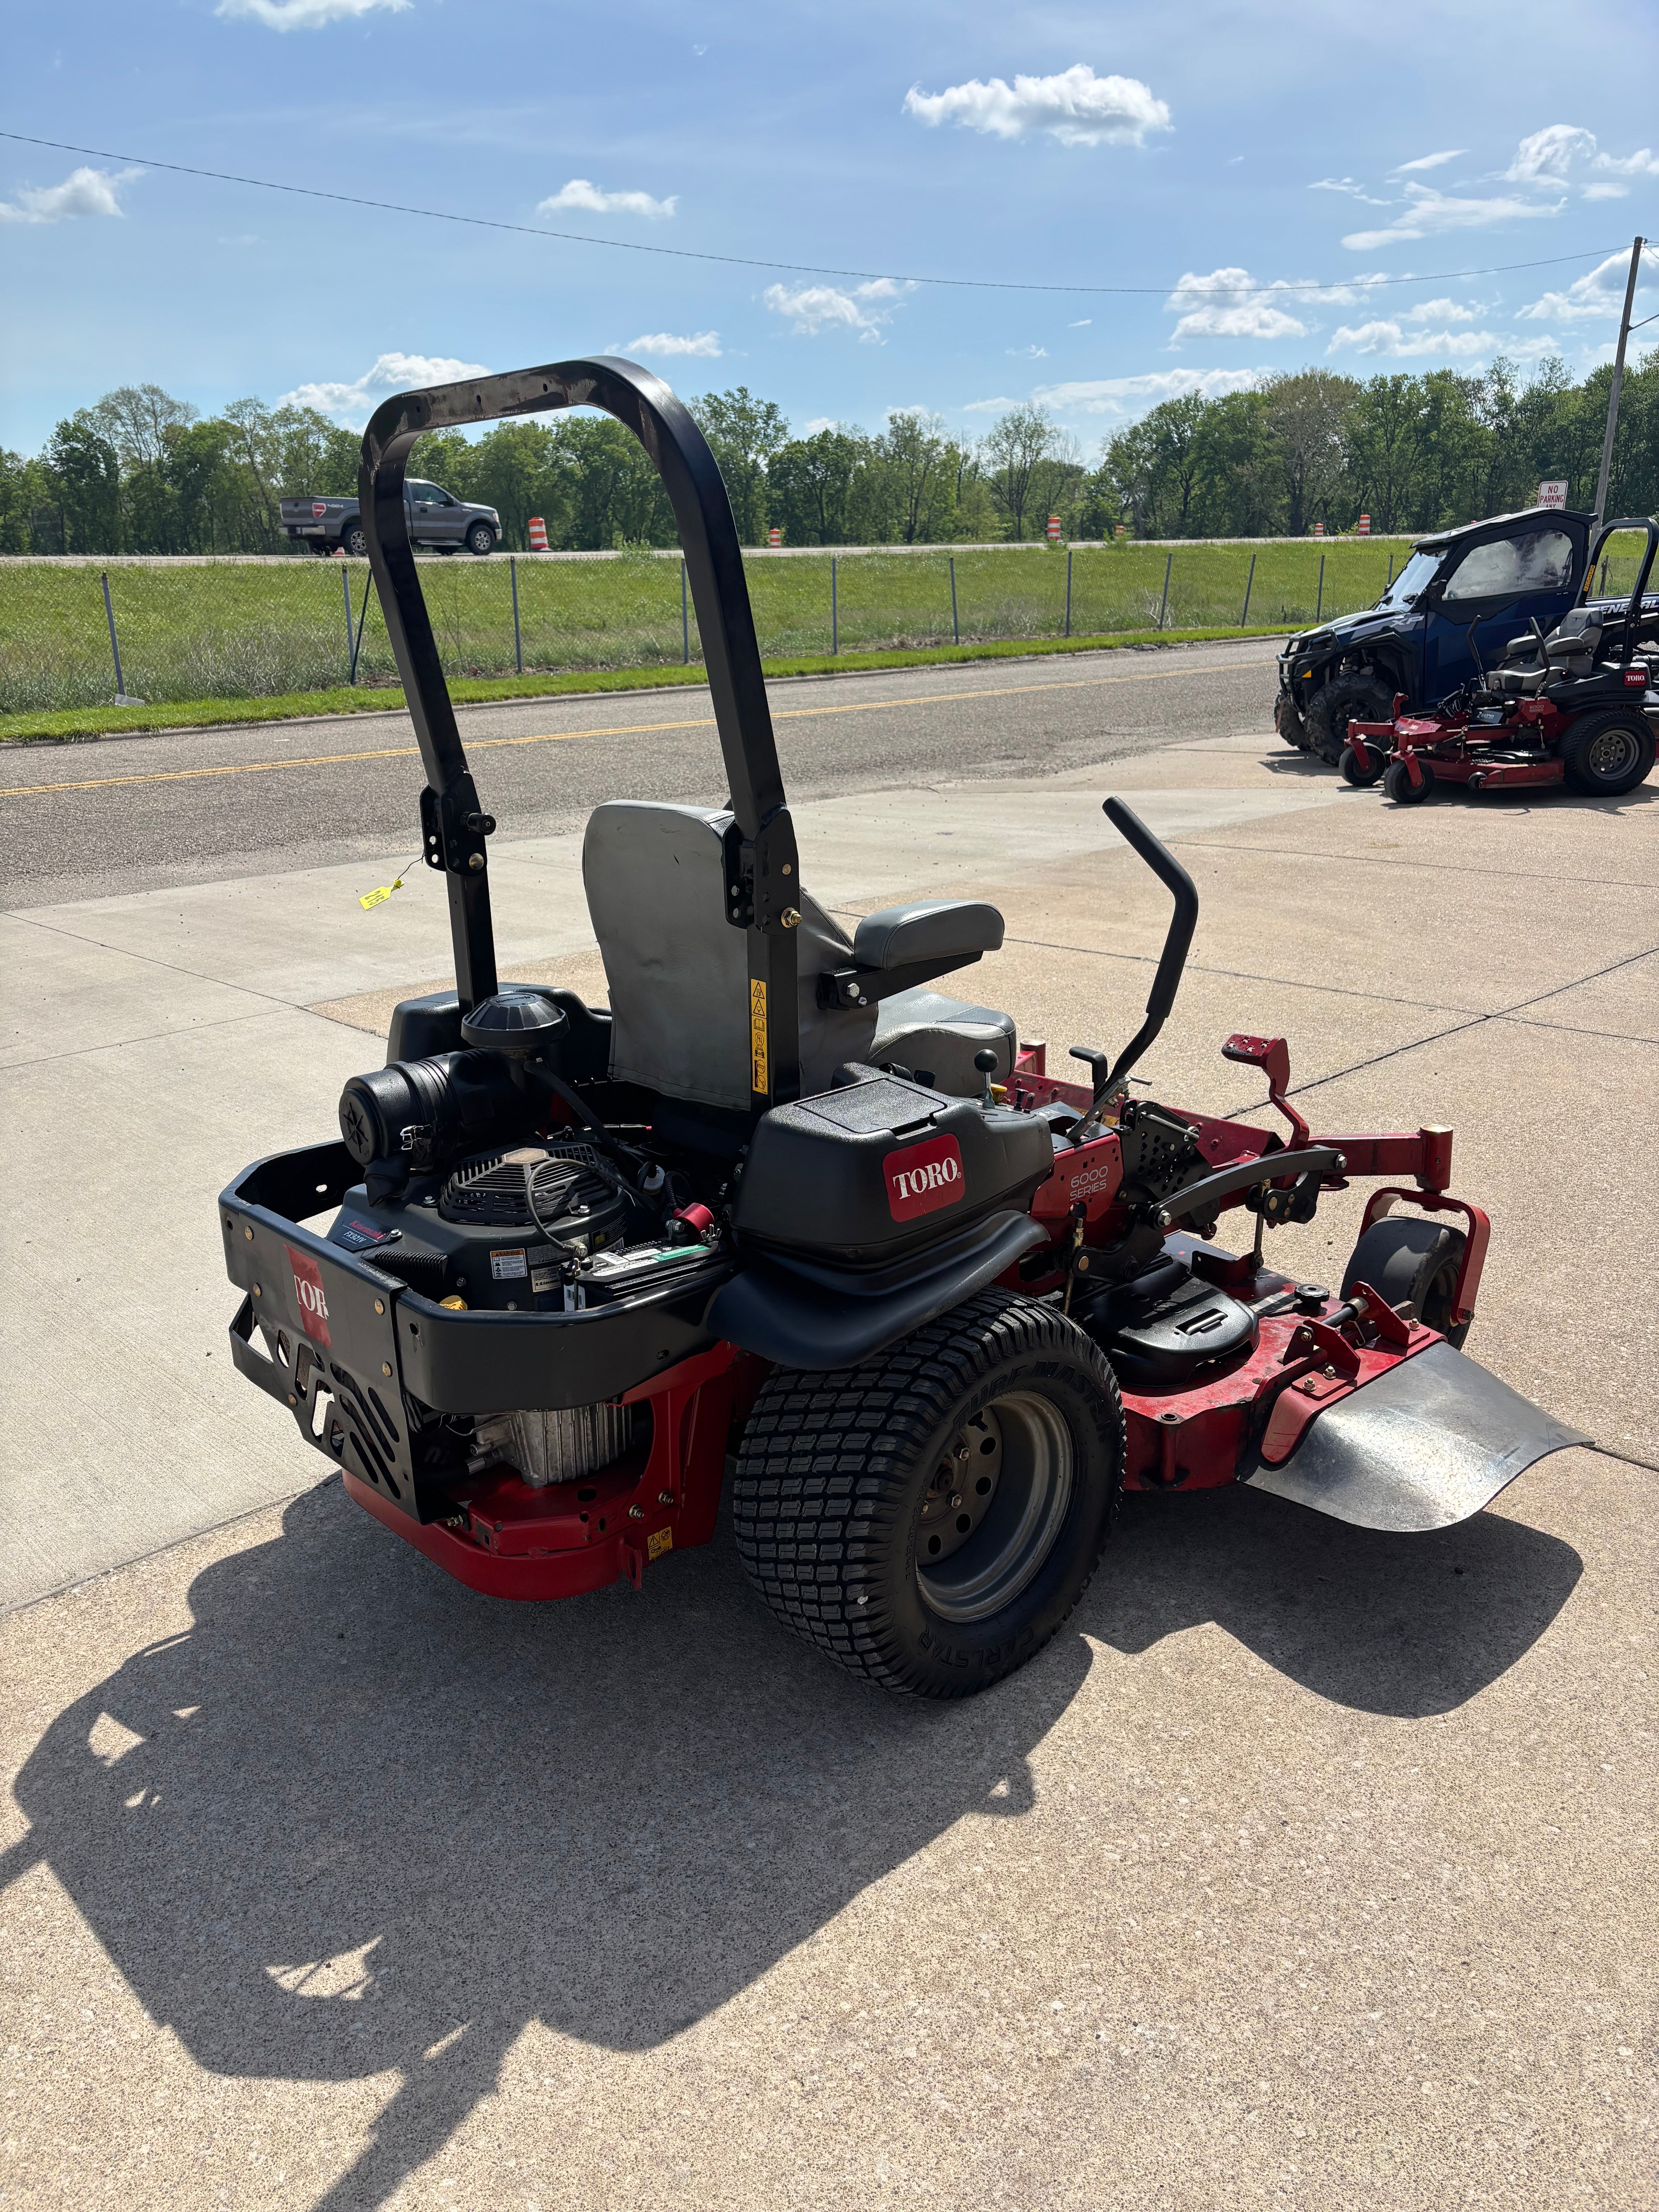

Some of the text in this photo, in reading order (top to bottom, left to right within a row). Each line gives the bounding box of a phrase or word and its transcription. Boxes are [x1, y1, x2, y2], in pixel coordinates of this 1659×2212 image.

[1548, 485, 1558, 494] NO
[1540, 495, 1564, 503] PARKING
[1596, 600, 1659, 614] ENEAL
[1389, 615, 1425, 627] XP
[365, 890, 385, 905] 215
[893, 1158, 958, 1199] TORO
[1071, 1166, 1108, 1188] 6000
[1070, 1179, 1107, 1201] SERIES
[343, 1231, 367, 1243] FX921V
[349, 1220, 386, 1239] Kawasaki
[953, 1360, 1113, 1443] TURF MASTER
[918, 1625, 1034, 1670] CARLSTAR
